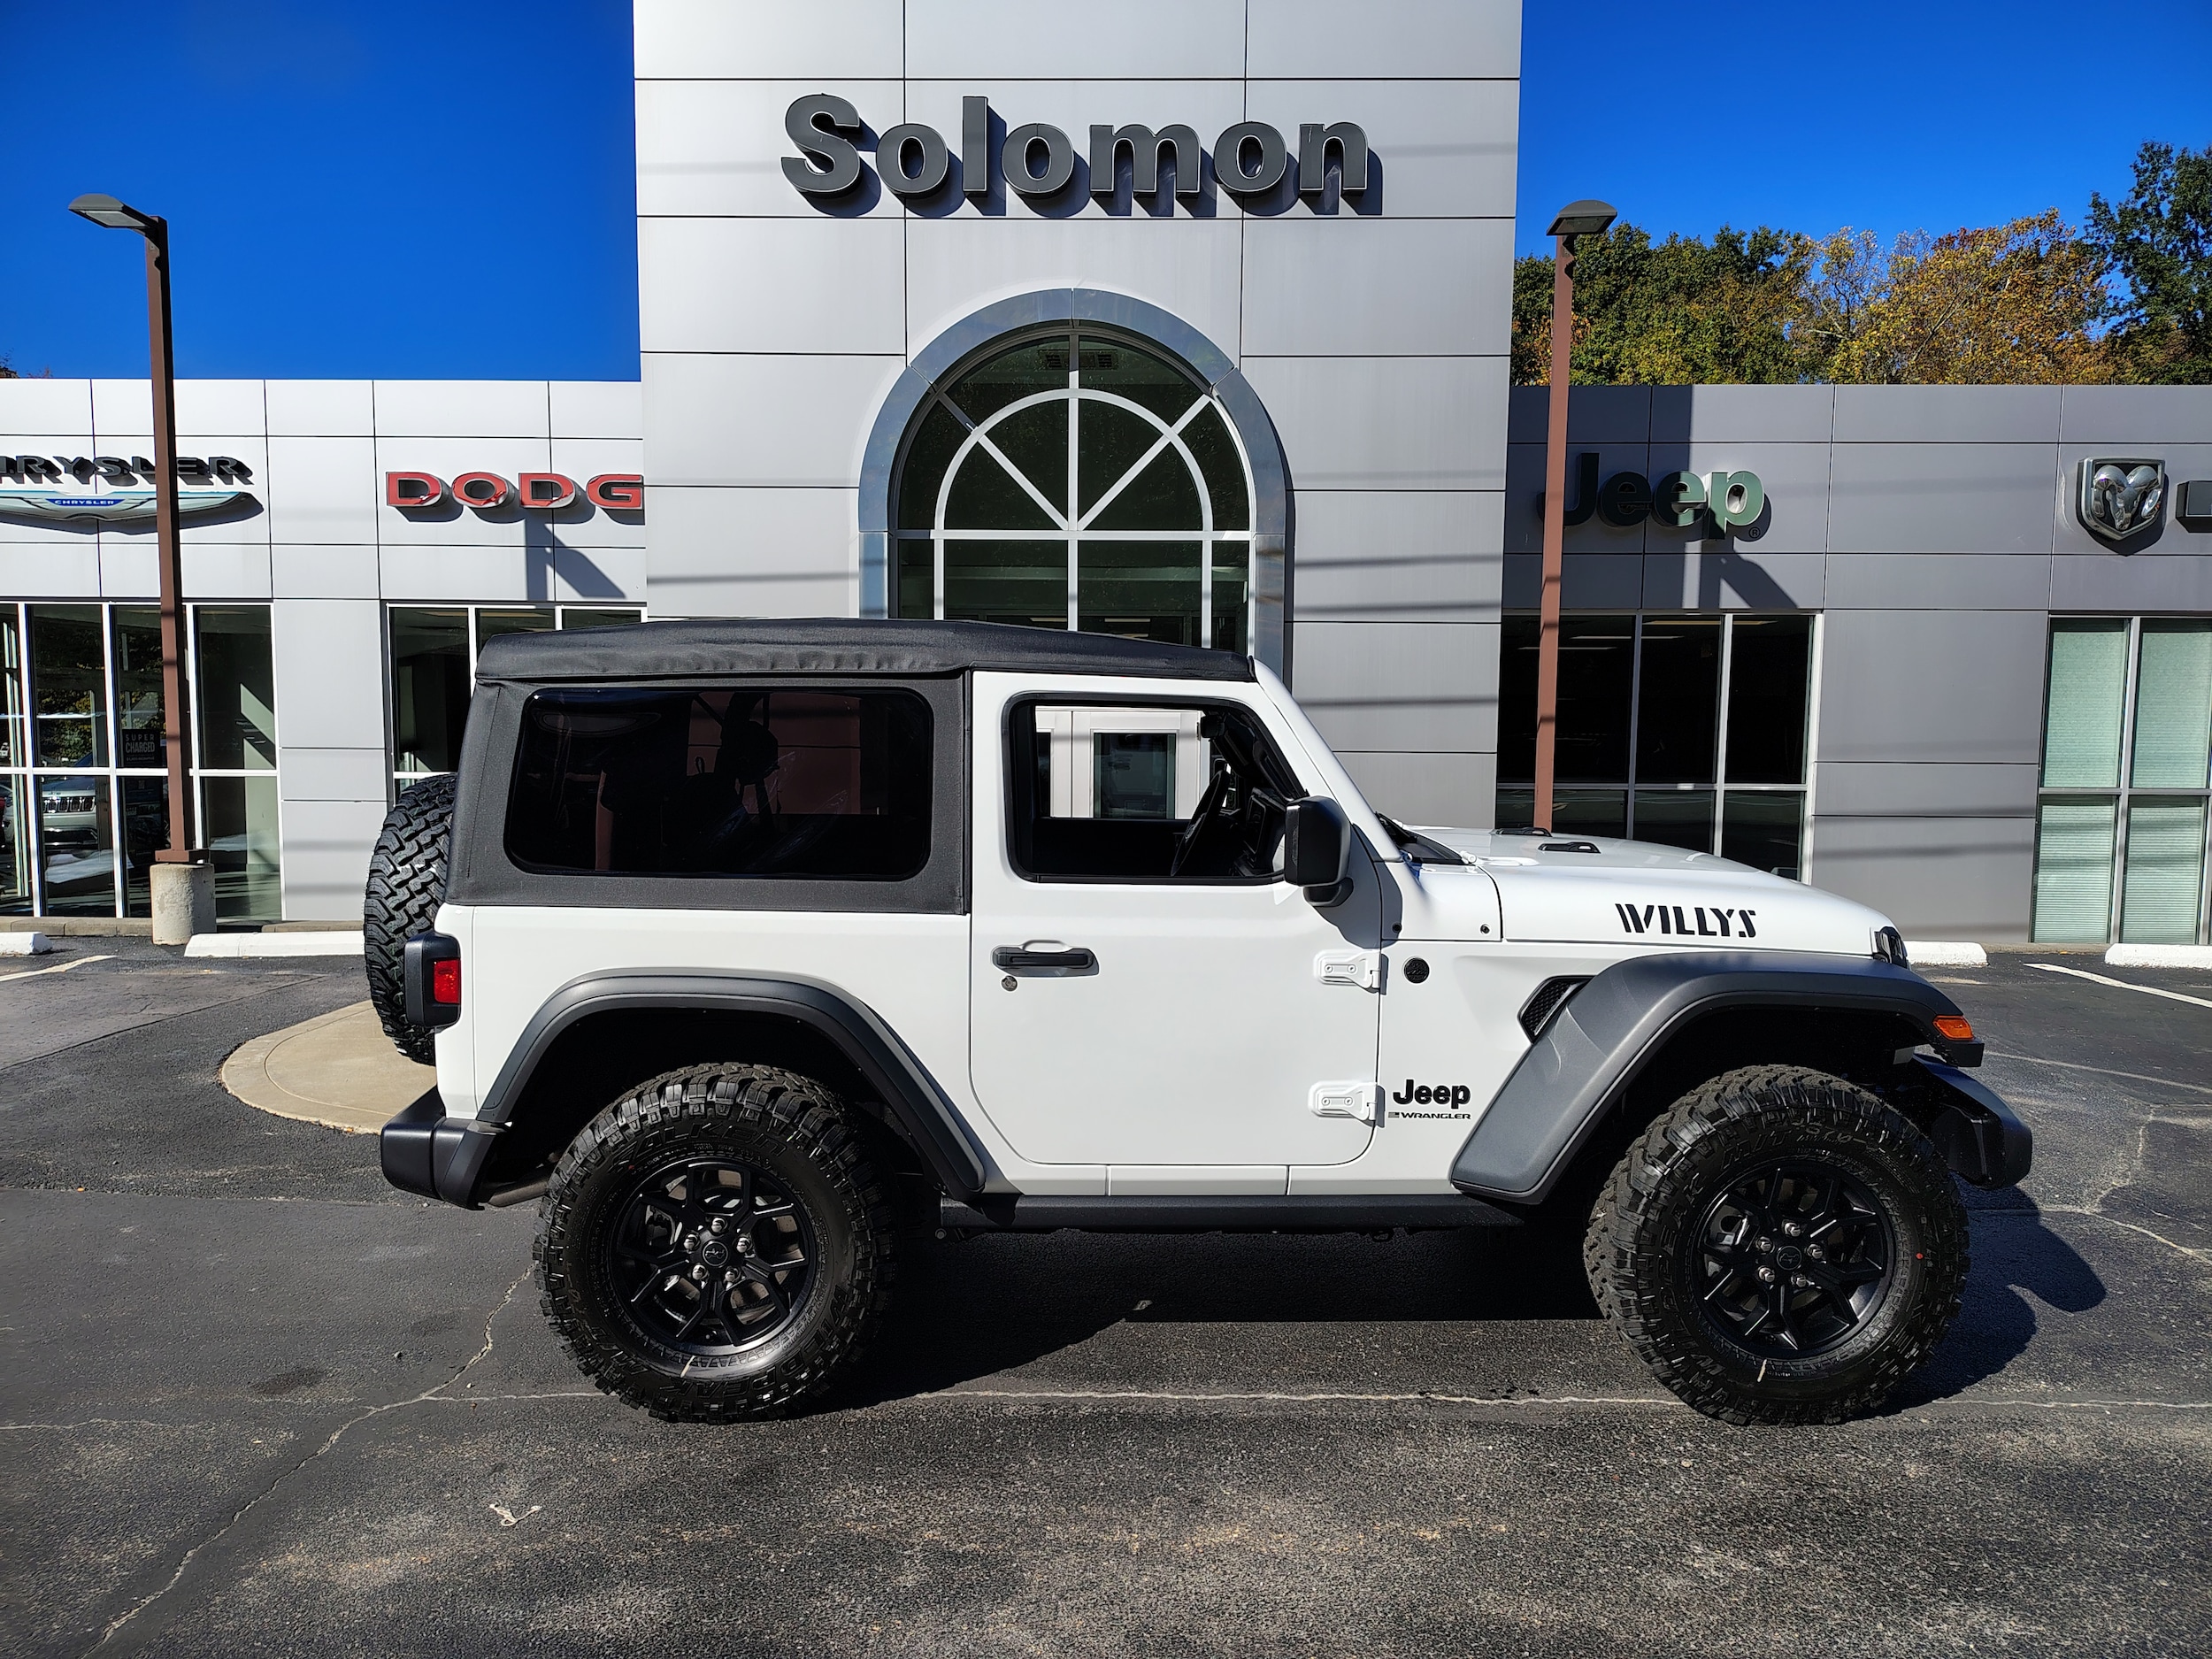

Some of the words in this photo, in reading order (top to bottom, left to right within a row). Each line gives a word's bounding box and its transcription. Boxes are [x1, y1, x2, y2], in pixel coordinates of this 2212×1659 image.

[780, 93, 1370, 198] Solomon
[0, 455, 244, 478] RYSLER
[1536, 452, 1764, 541] Jeep
[125, 741, 156, 754] CHARGED
[1615, 902, 1756, 938] WILLYS
[1393, 1079, 1471, 1110] Jeep
[1401, 1111, 1471, 1120] WRANGLER
